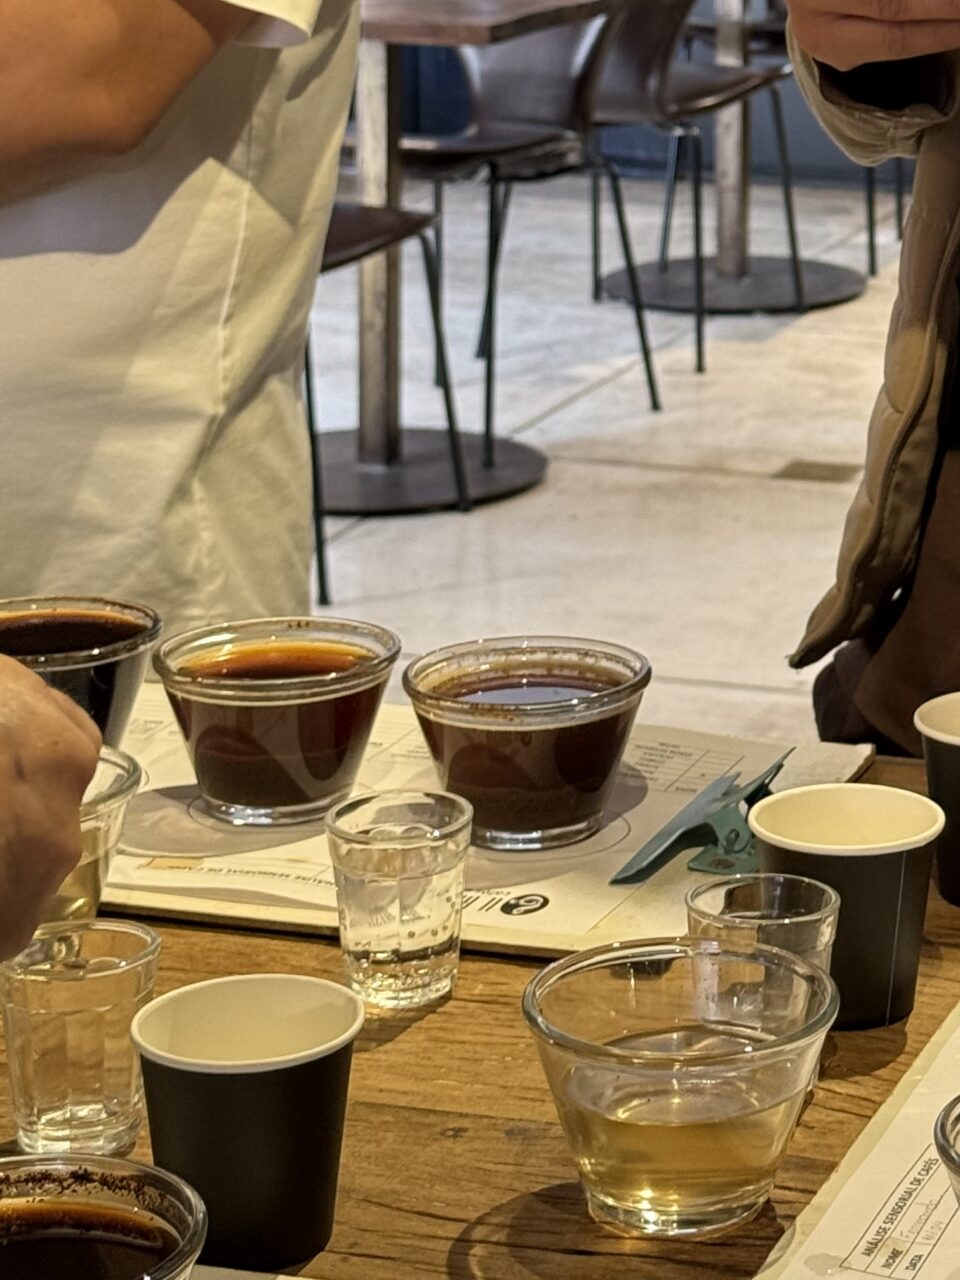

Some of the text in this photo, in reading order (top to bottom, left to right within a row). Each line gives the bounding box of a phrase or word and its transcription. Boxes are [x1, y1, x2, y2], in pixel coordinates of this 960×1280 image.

[861, 1225, 891, 1257] ANÁLISE
[883, 1186, 918, 1226] SENSORIAL
[909, 1176, 925, 1187] DE
[881, 1247, 904, 1270] NOME
[904, 1253, 925, 1272] DATA
